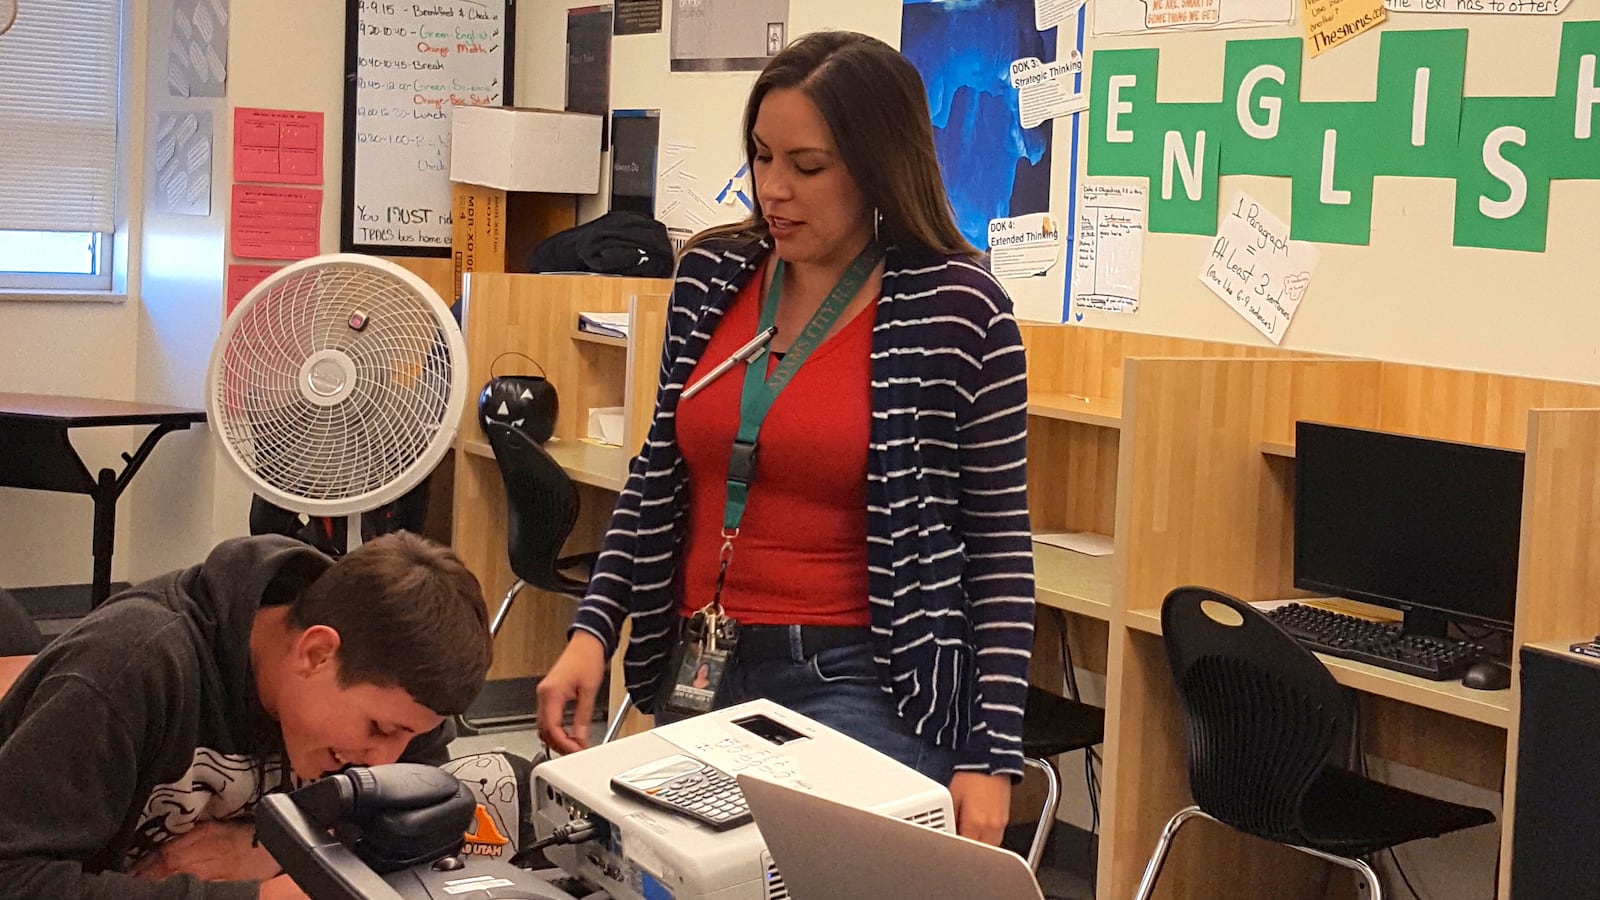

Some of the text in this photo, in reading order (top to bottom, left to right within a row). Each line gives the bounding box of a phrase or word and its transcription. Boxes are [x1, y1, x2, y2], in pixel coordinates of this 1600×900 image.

[1457, 0, 1484, 11] has
[1490, 0, 1505, 12] to
[1012, 59, 1040, 75] DOK 3:
[1014, 61, 1082, 88] Strategic Thinking
[357, 205, 453, 225] You MUST rid
[990, 220, 1015, 232] DOK 4:
[1246, 203, 1289, 257] Paragraph
[419, 229, 441, 243] home
[990, 233, 1024, 247] Extended
[1226, 248, 1255, 284] Least
[1254, 273, 1270, 296] 3
[806, 305, 836, 339] CITY
[472, 844, 503, 857] UTAH
